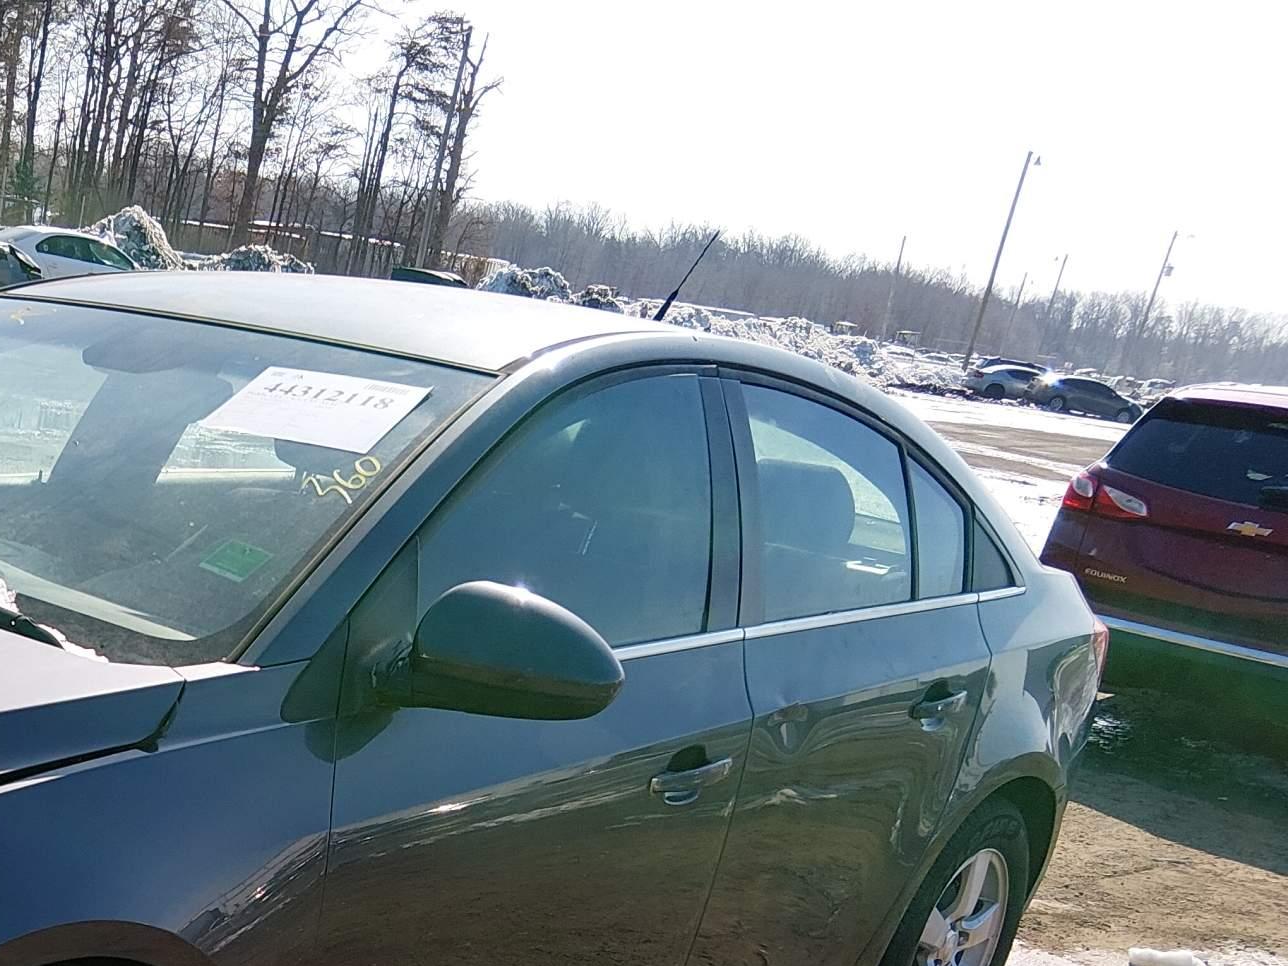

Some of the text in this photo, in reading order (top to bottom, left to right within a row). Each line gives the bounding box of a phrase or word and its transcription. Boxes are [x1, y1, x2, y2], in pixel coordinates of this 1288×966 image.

[264, 382, 395, 410] 44312118
[300, 455, 381, 504] 360
[1084, 567, 1128, 583] EQUINOX
